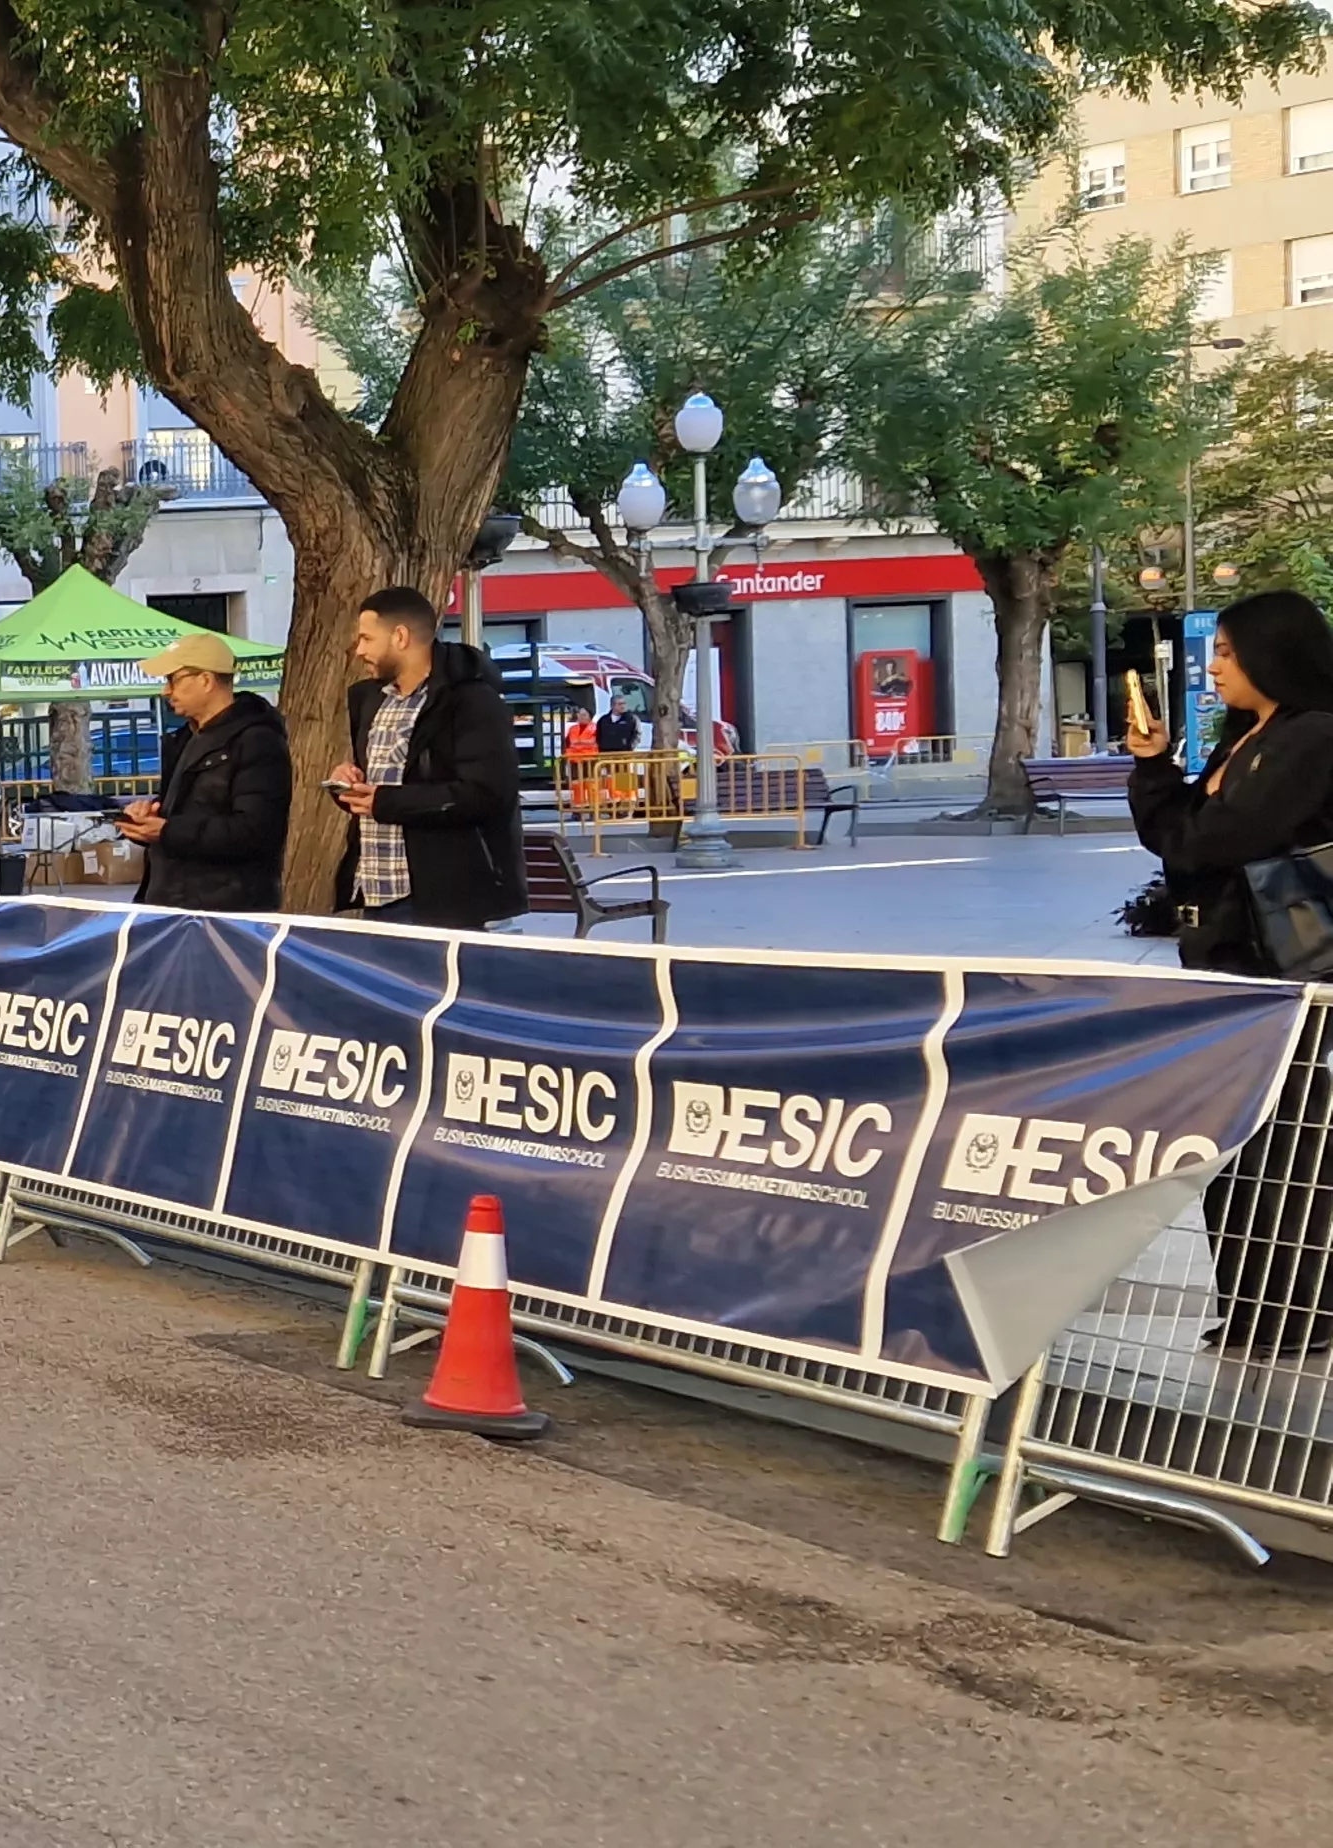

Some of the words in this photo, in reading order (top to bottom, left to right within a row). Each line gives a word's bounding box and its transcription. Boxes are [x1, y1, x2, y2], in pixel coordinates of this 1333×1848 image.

[193, 578, 202, 591] 2
[84, 628, 183, 639] FARTLECK
[101, 640, 172, 650] SPOR
[7, 664, 71, 675] FARTLECK
[4, 994, 89, 1056] ESIC
[141, 1013, 235, 1080] ESIC
[293, 1034, 407, 1108] ESIC
[486, 1058, 617, 1142] ESIC
[719, 1087, 892, 1178] ESIC
